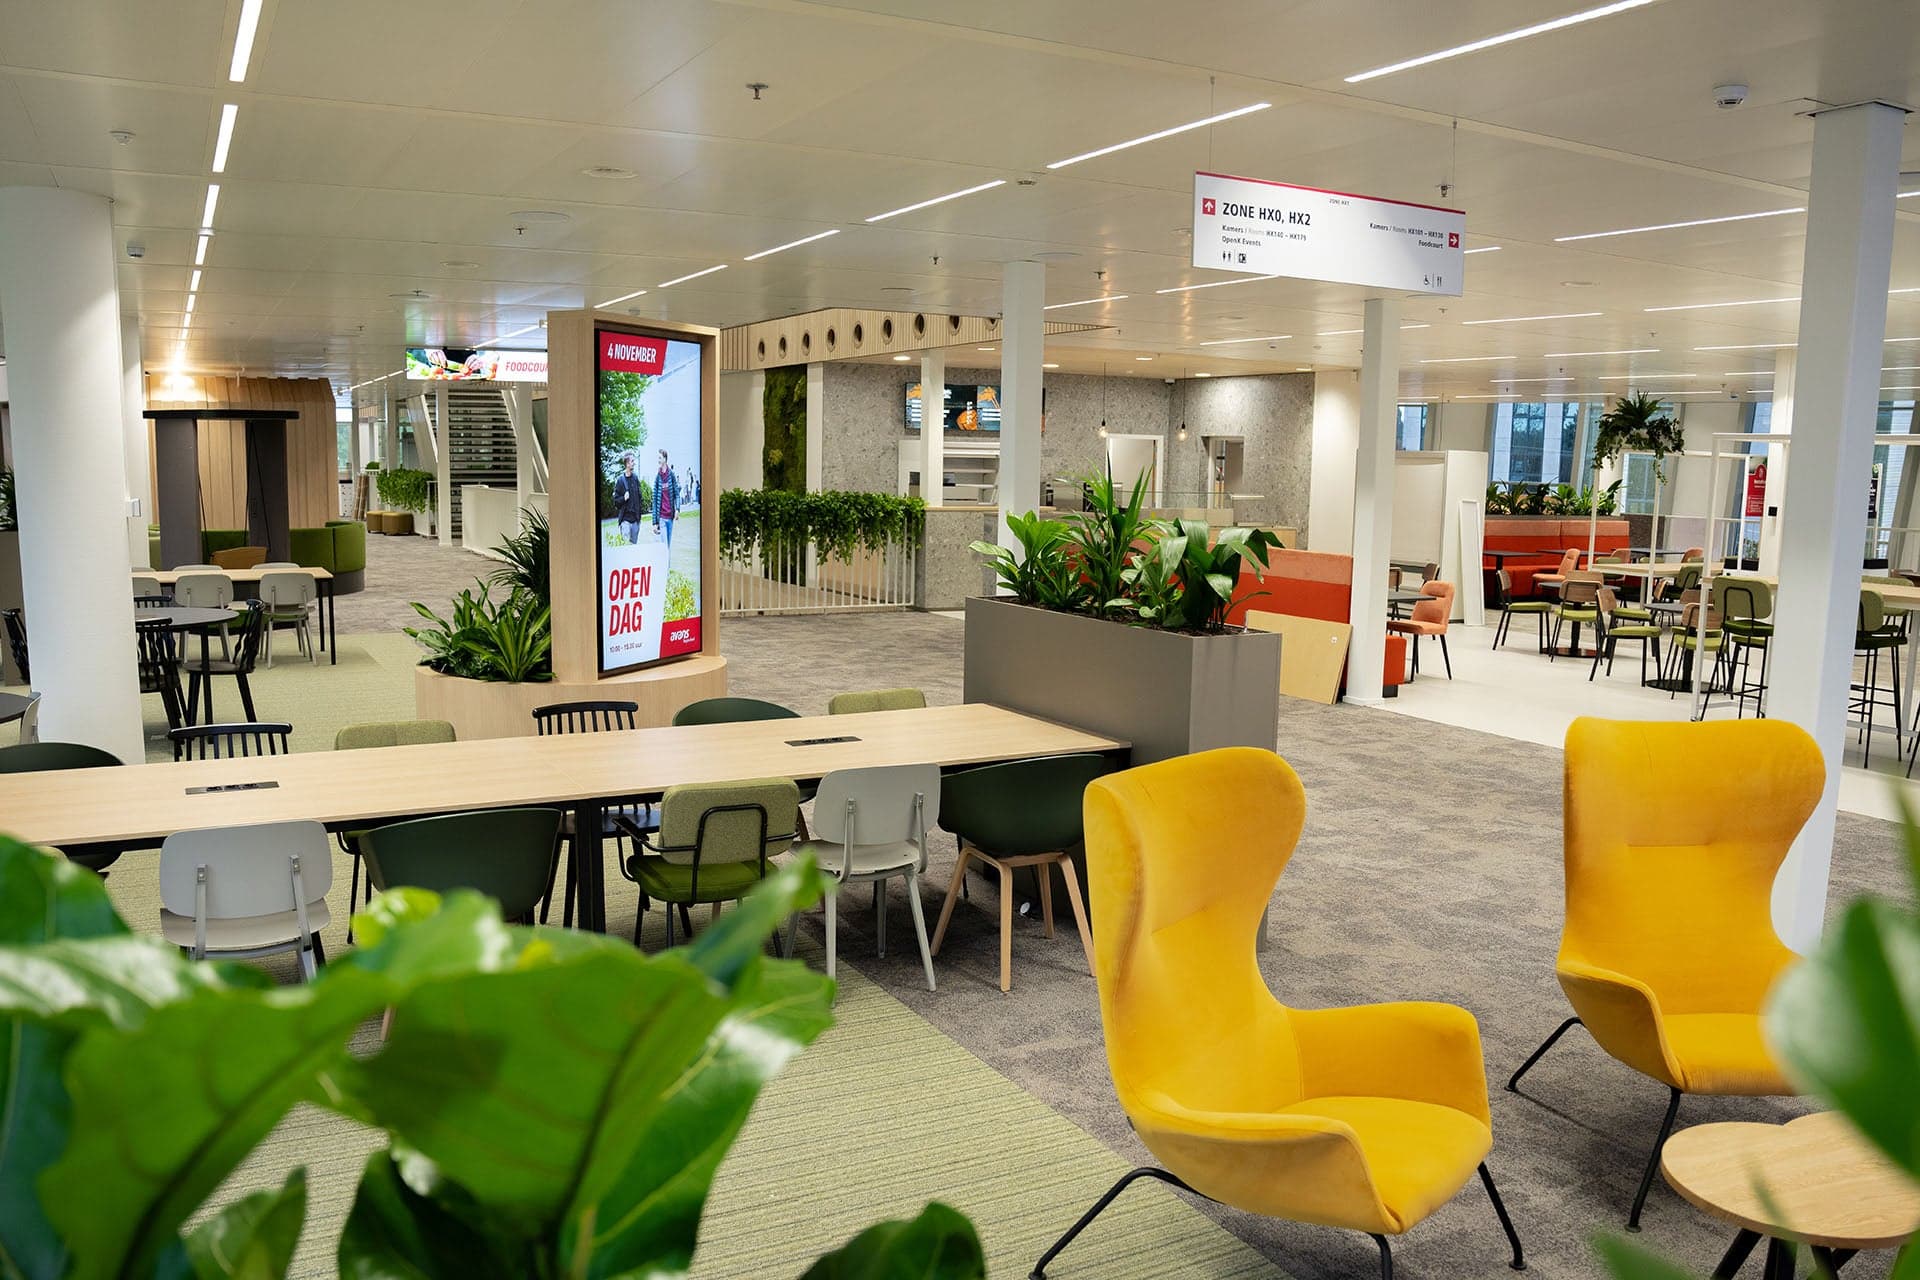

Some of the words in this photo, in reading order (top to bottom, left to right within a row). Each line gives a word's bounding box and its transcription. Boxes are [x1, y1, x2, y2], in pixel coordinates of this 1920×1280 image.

[1222, 202, 1255, 219] ZONE
[1259, 207, 1285, 225] HX0,
[1289, 211, 1311, 226] HX2
[1222, 224, 1244, 234] Kamers
[1369, 222, 1389, 231] Kamers
[1242, 238, 1262, 247] Events
[1418, 239, 1443, 249] Foodcourt
[607, 342, 614, 360] 4
[614, 343, 657, 363] NOVEMBER
[608, 565, 652, 602] OPEN
[608, 601, 643, 637] DAG
[670, 628, 690, 642] avans
